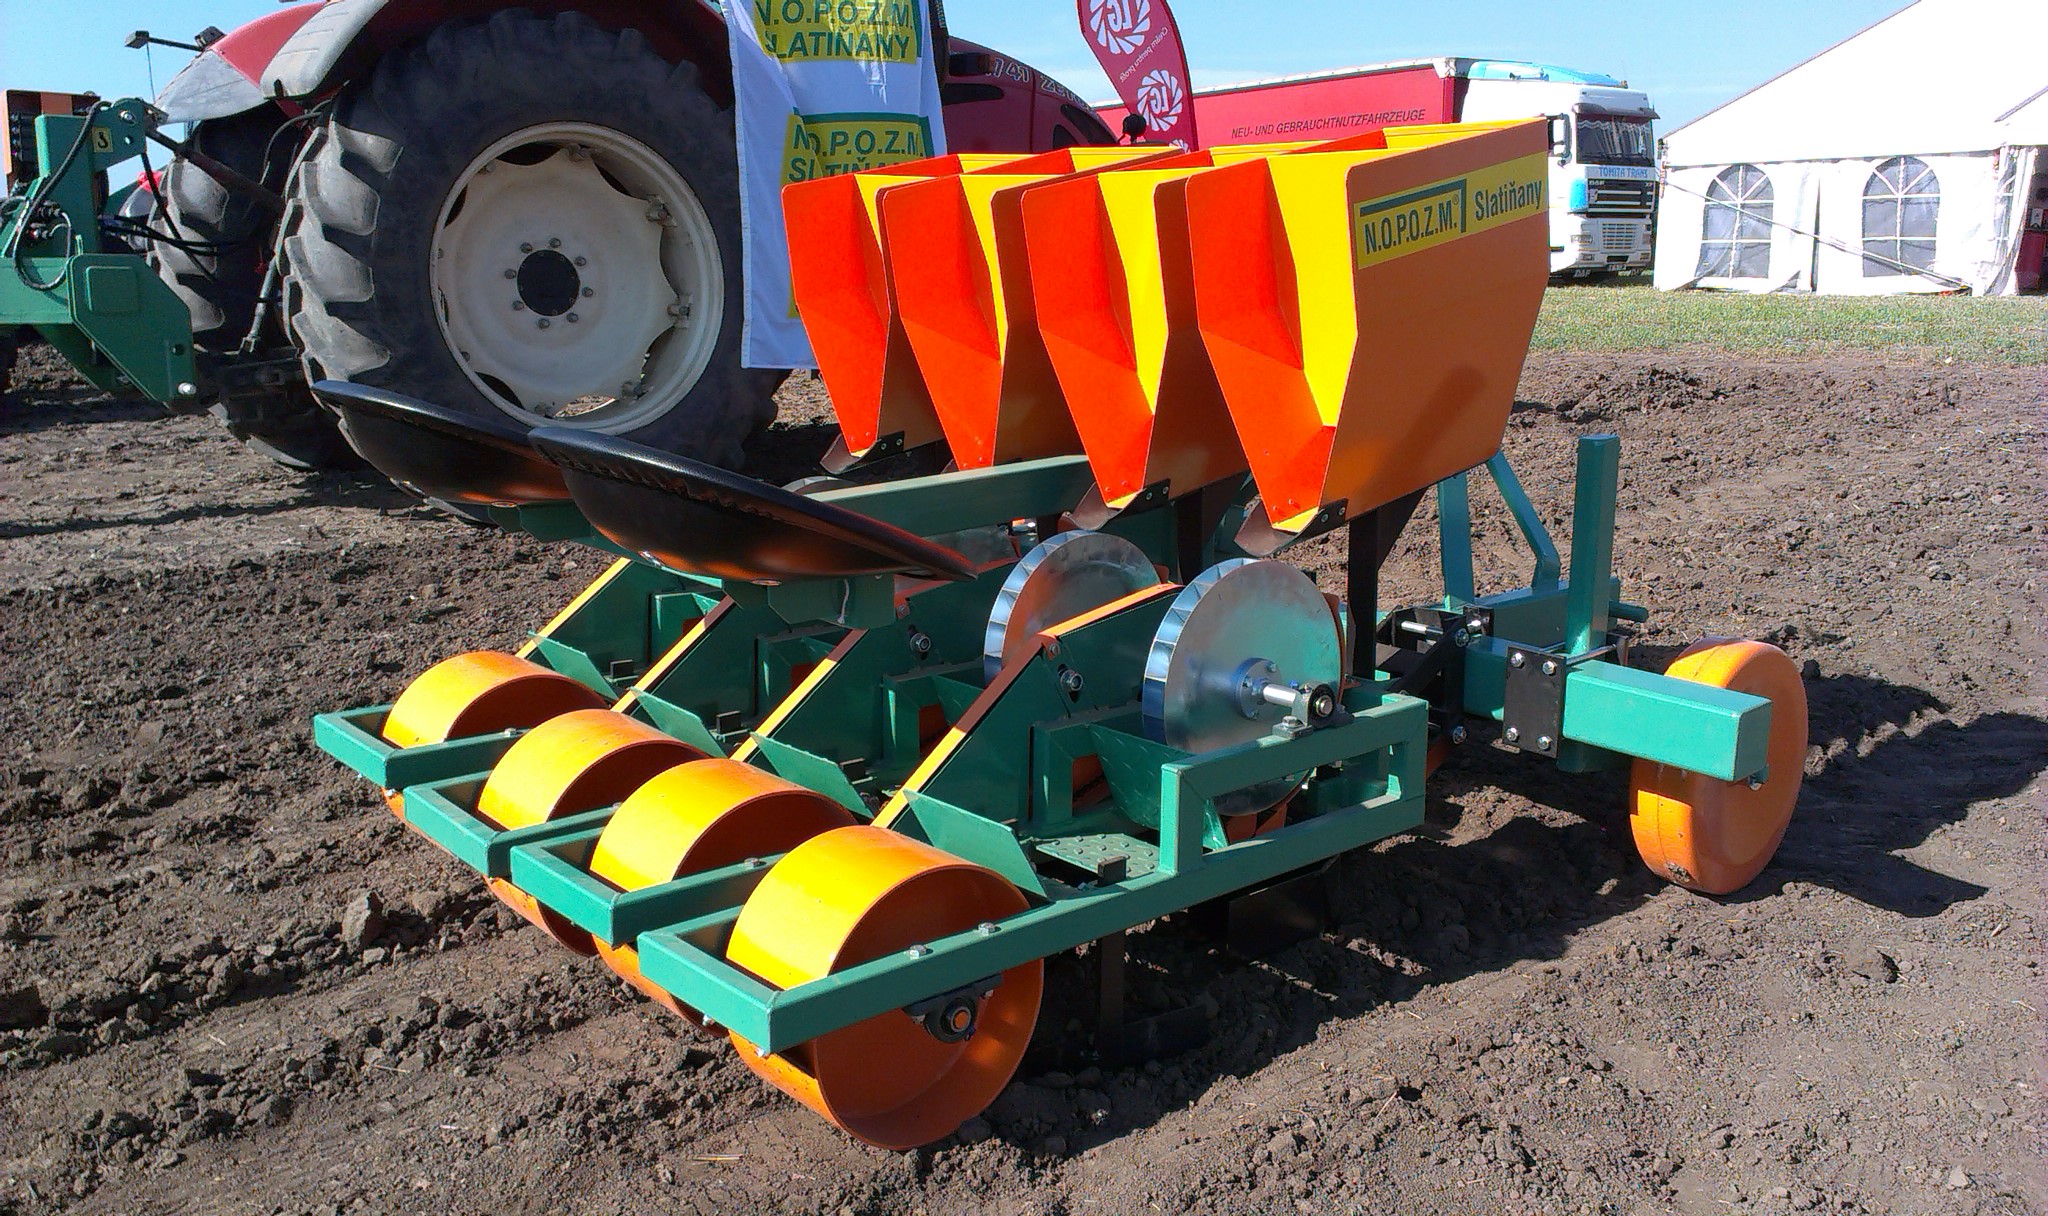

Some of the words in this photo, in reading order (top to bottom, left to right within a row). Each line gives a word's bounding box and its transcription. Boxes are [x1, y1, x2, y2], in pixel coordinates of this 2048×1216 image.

[1254, 123, 1275, 136] UND
[1276, 108, 1427, 135] GEBRAUCHTNUTZFAHRZEUGE
[1473, 180, 1543, 222] Slatiňany
